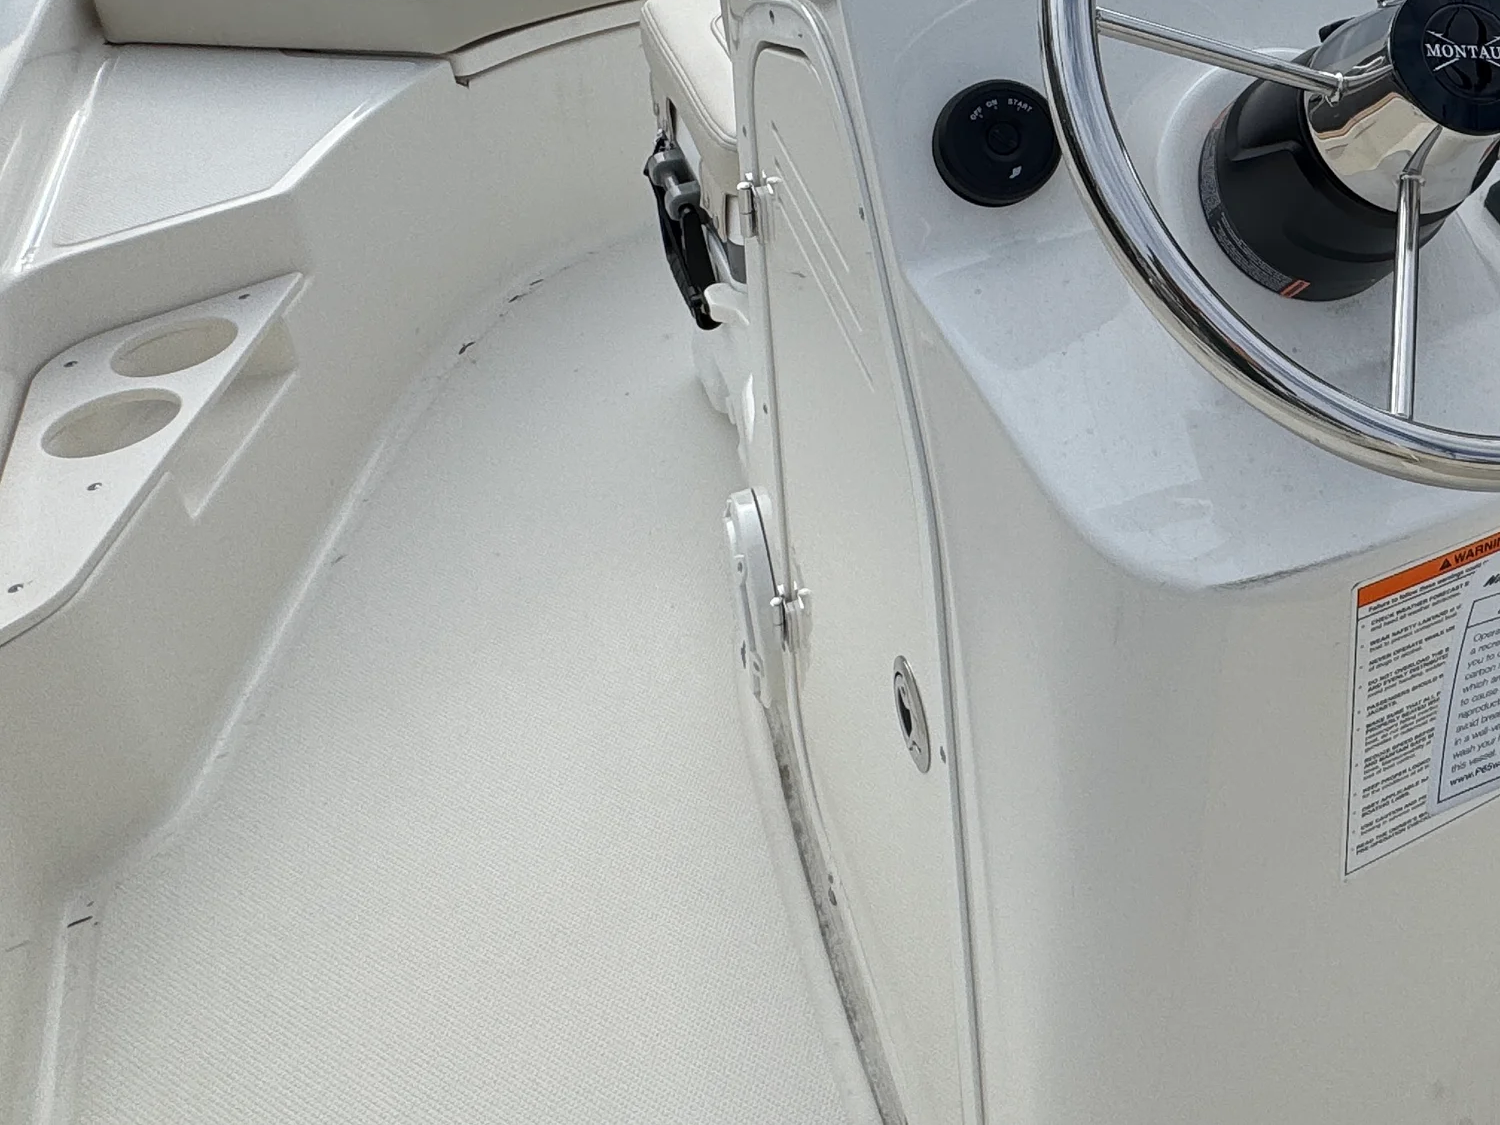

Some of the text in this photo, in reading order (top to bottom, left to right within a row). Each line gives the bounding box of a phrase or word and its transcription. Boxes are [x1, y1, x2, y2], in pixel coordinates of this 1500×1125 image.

[969, 98, 1033, 121] OFF ON START
[1368, 600, 1389, 611] Failure
[1399, 589, 1417, 599] follow
[1429, 583, 1462, 601] FORECAST
[1469, 647, 1476, 655] a
[1467, 657, 1484, 669] you
[1486, 653, 1495, 661] to
[1464, 664, 1495, 680] carbon
[1462, 678, 1488, 693] which
[1460, 698, 1469, 706] to
[1471, 688, 1498, 702] cause
[1456, 718, 1479, 732] avoid
[1452, 745, 1475, 759] wash
[1477, 737, 1496, 751] your
[1451, 761, 1466, 773] this
[1469, 749, 1495, 765] vessel.
